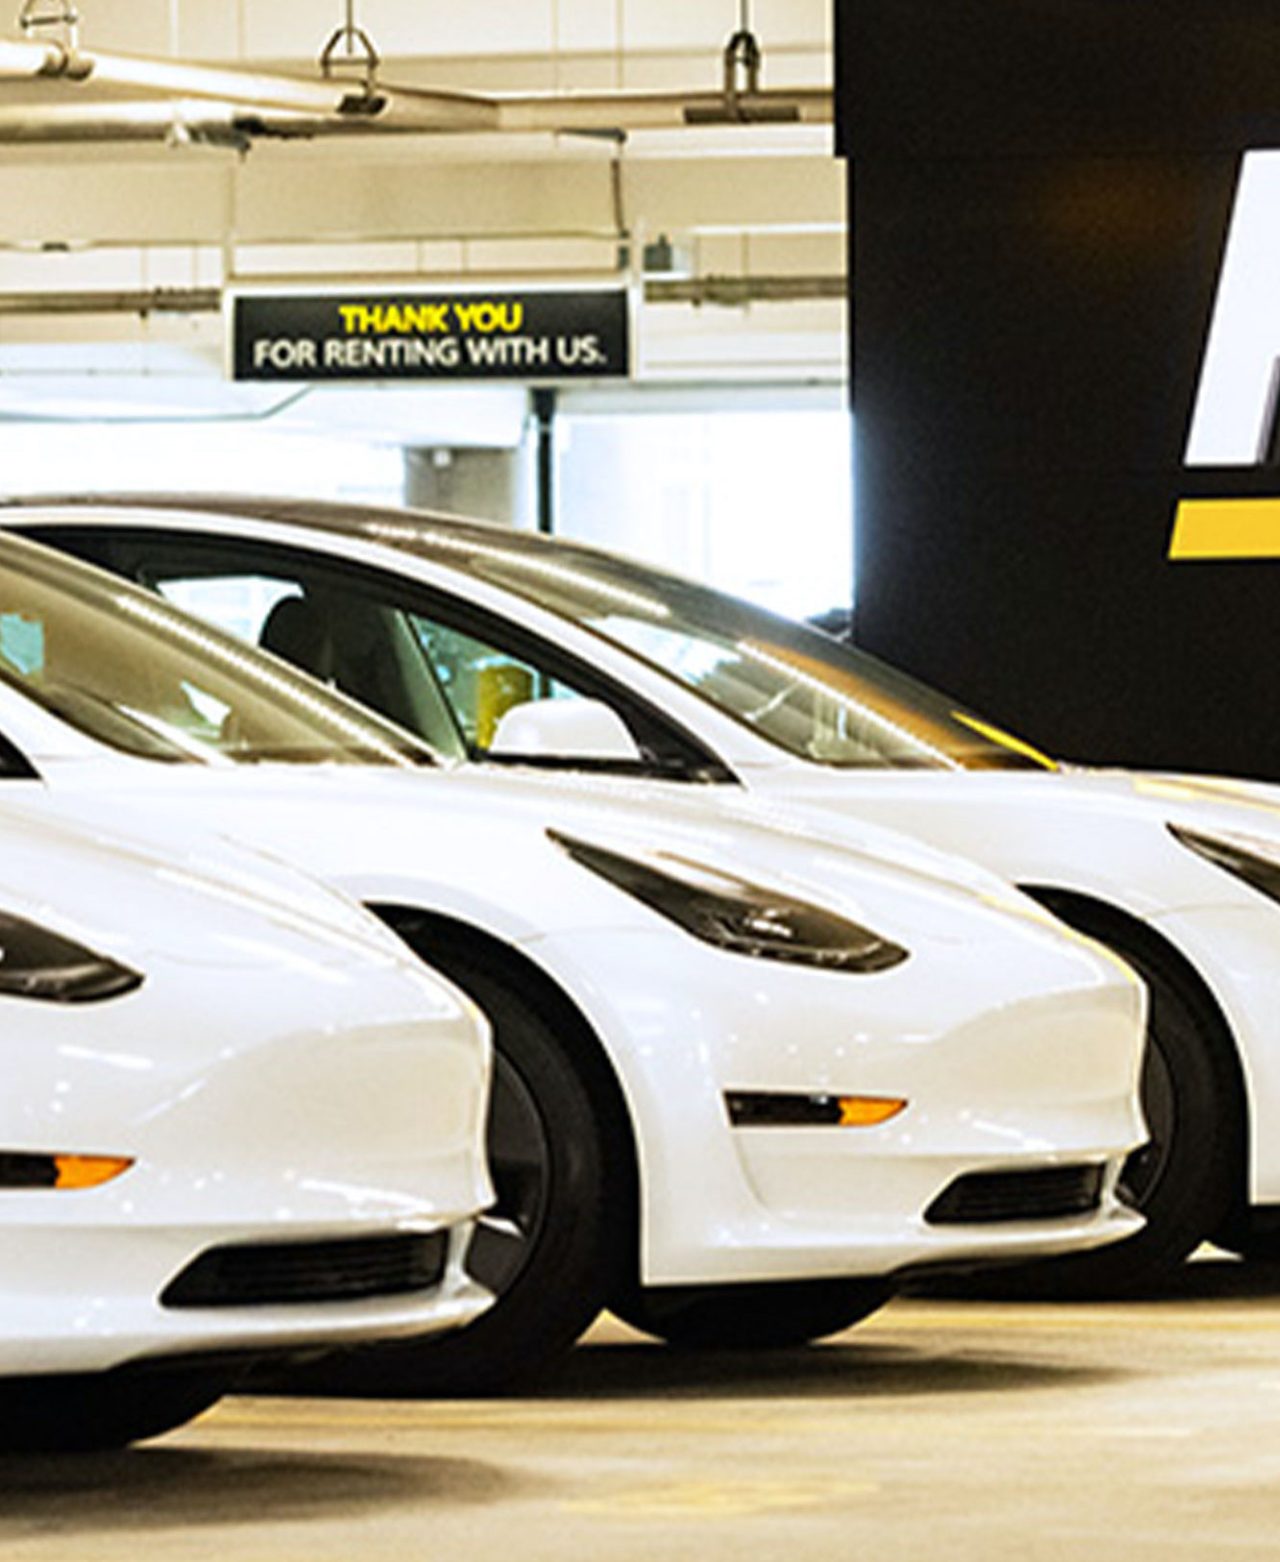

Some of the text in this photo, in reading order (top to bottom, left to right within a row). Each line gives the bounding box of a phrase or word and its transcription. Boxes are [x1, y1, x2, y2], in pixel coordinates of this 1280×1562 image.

[340, 303, 523, 333] THANK YOU
[253, 336, 606, 368] FOR RENTING WITH US.
